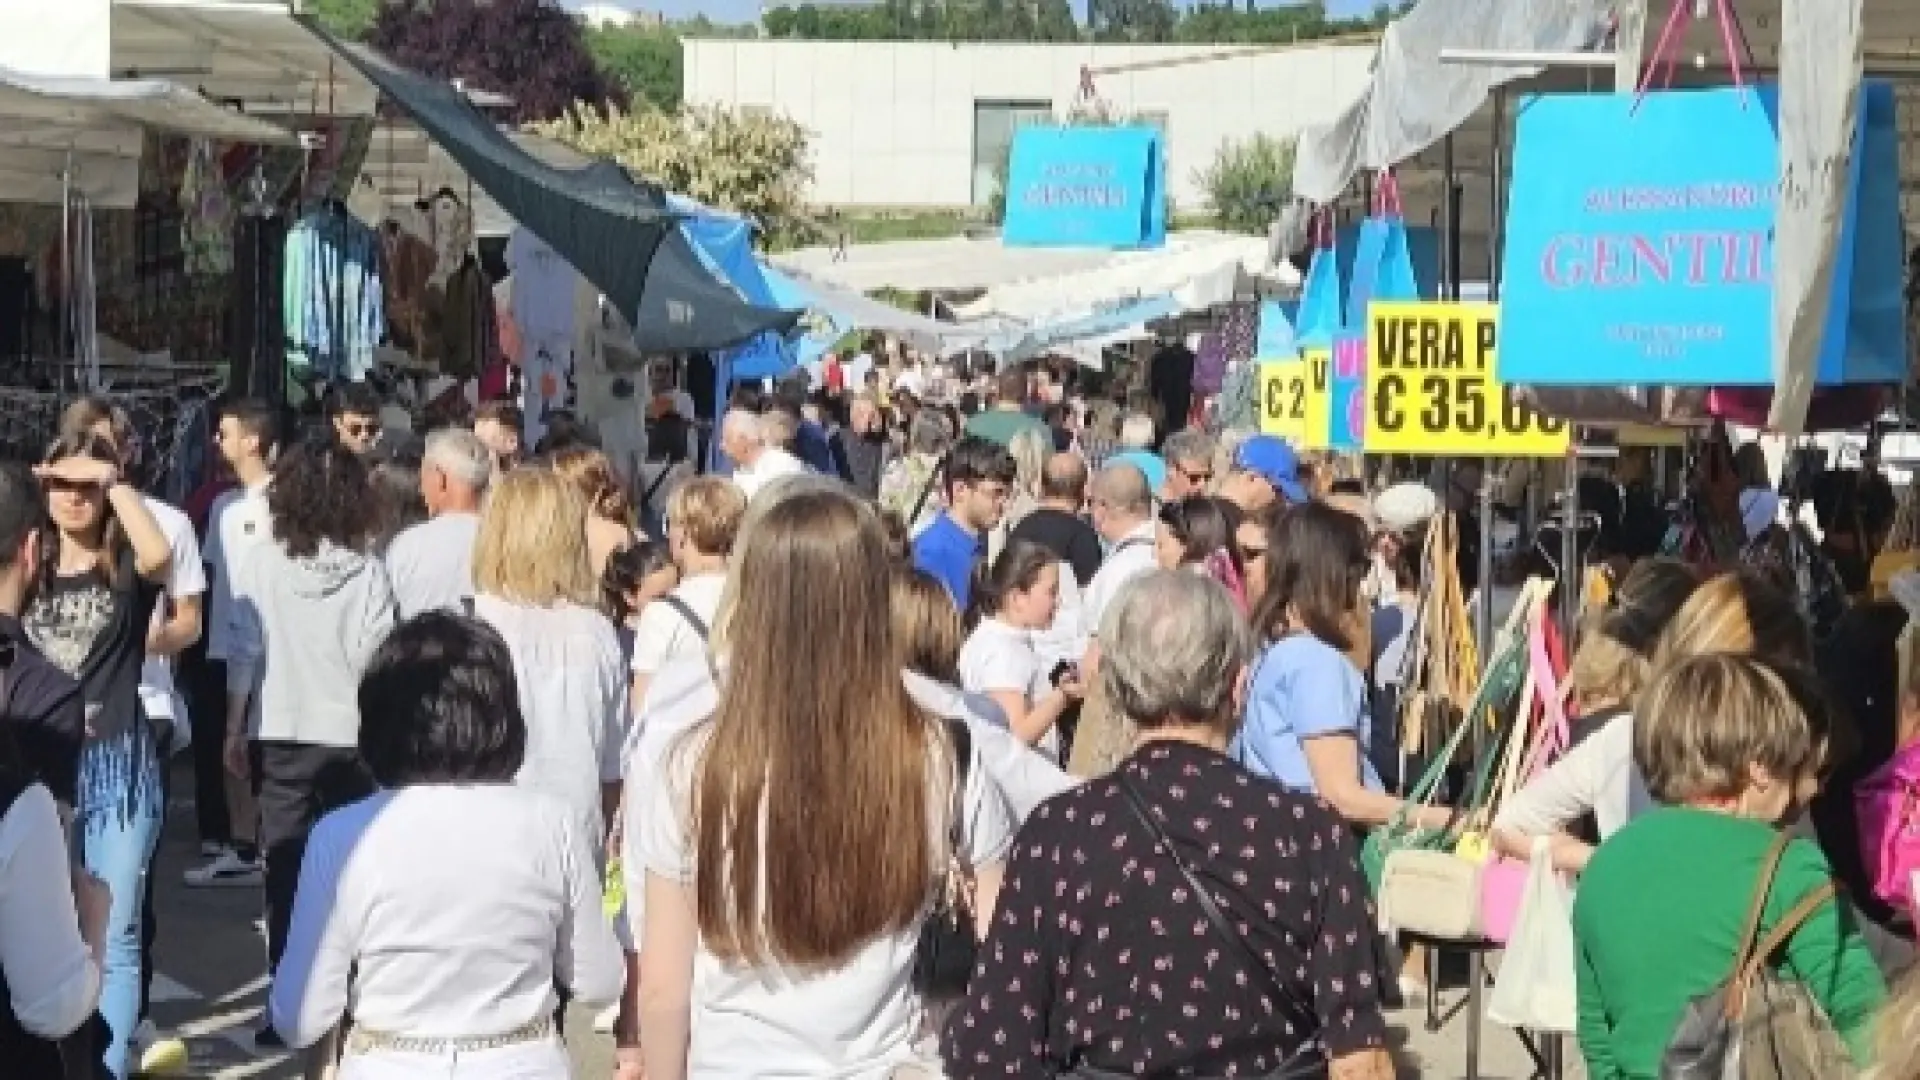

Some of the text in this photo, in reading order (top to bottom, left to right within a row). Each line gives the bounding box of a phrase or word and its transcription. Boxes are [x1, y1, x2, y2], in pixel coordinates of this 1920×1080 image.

[1375, 316, 1464, 370] VERA
[1289, 376, 1305, 418] 2
[1375, 373, 1406, 433] €
